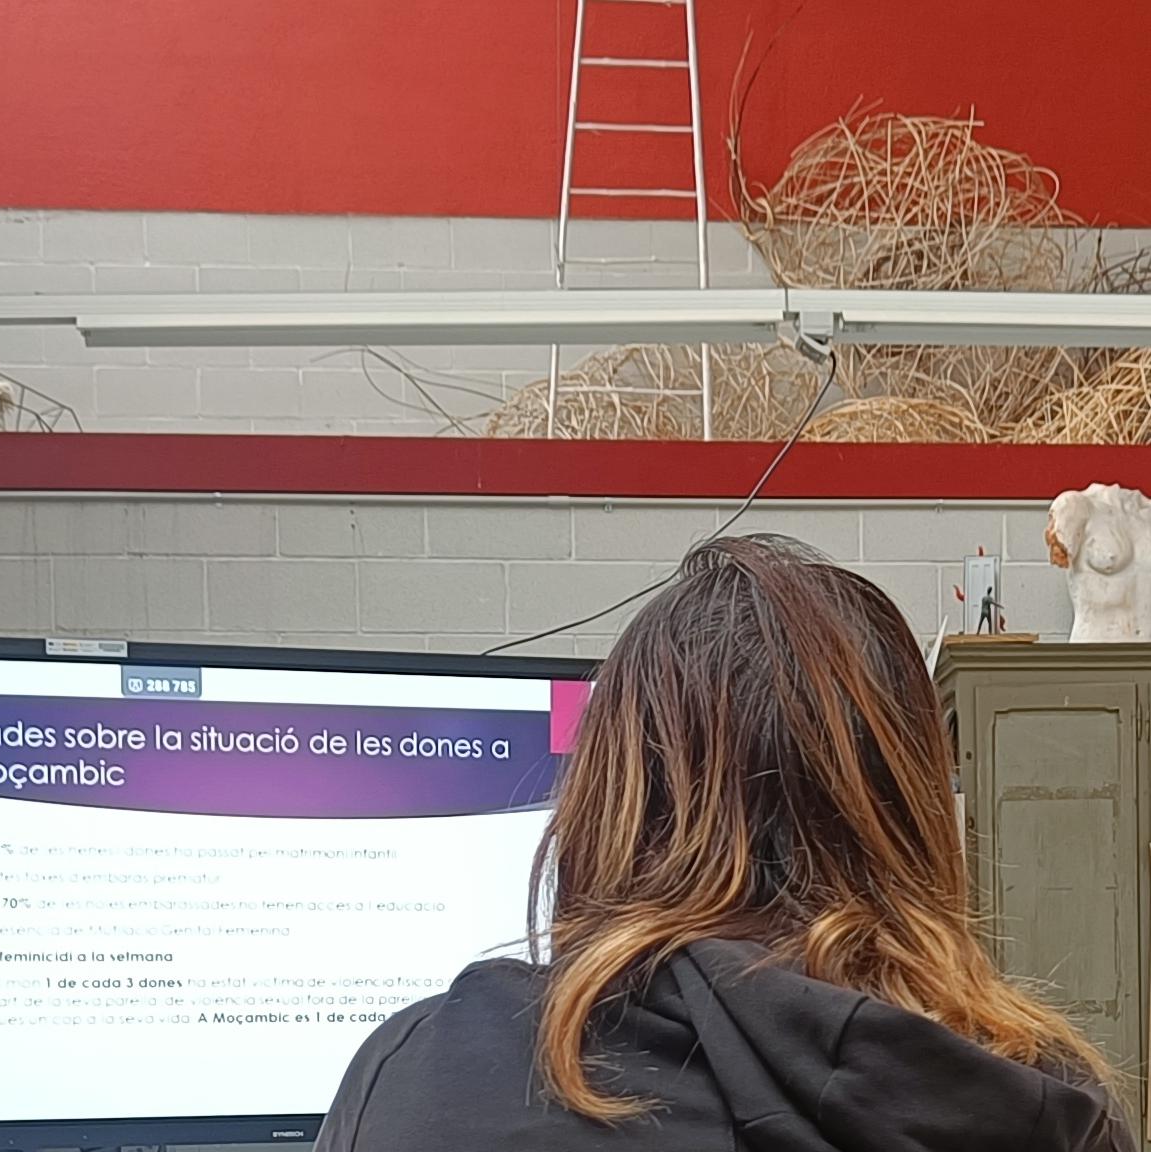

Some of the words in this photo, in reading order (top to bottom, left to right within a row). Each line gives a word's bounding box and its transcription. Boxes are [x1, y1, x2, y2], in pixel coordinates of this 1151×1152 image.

[64, 723, 146, 750] sobre
[155, 724, 182, 751] la
[190, 725, 299, 754] situació
[309, 729, 348, 755] de
[356, 730, 392, 757] les
[399, 732, 483, 759] dones
[491, 739, 510, 759] a
[3, 897, 32, 909] 70%
[0, 951, 73, 963] feminicidi
[77, 953, 87, 963] a
[91, 951, 105, 963] la
[110, 951, 174, 963] setmana
[57, 977, 77, 989] de
[82, 977, 122, 989] cada
[126, 977, 134, 989] 3
[139, 977, 184, 989] dones
[198, 1012, 208, 1024] A
[213, 1010, 290, 1026] Moçambic
[327, 1011, 345, 1023] de
[350, 1011, 388, 1023] cada
